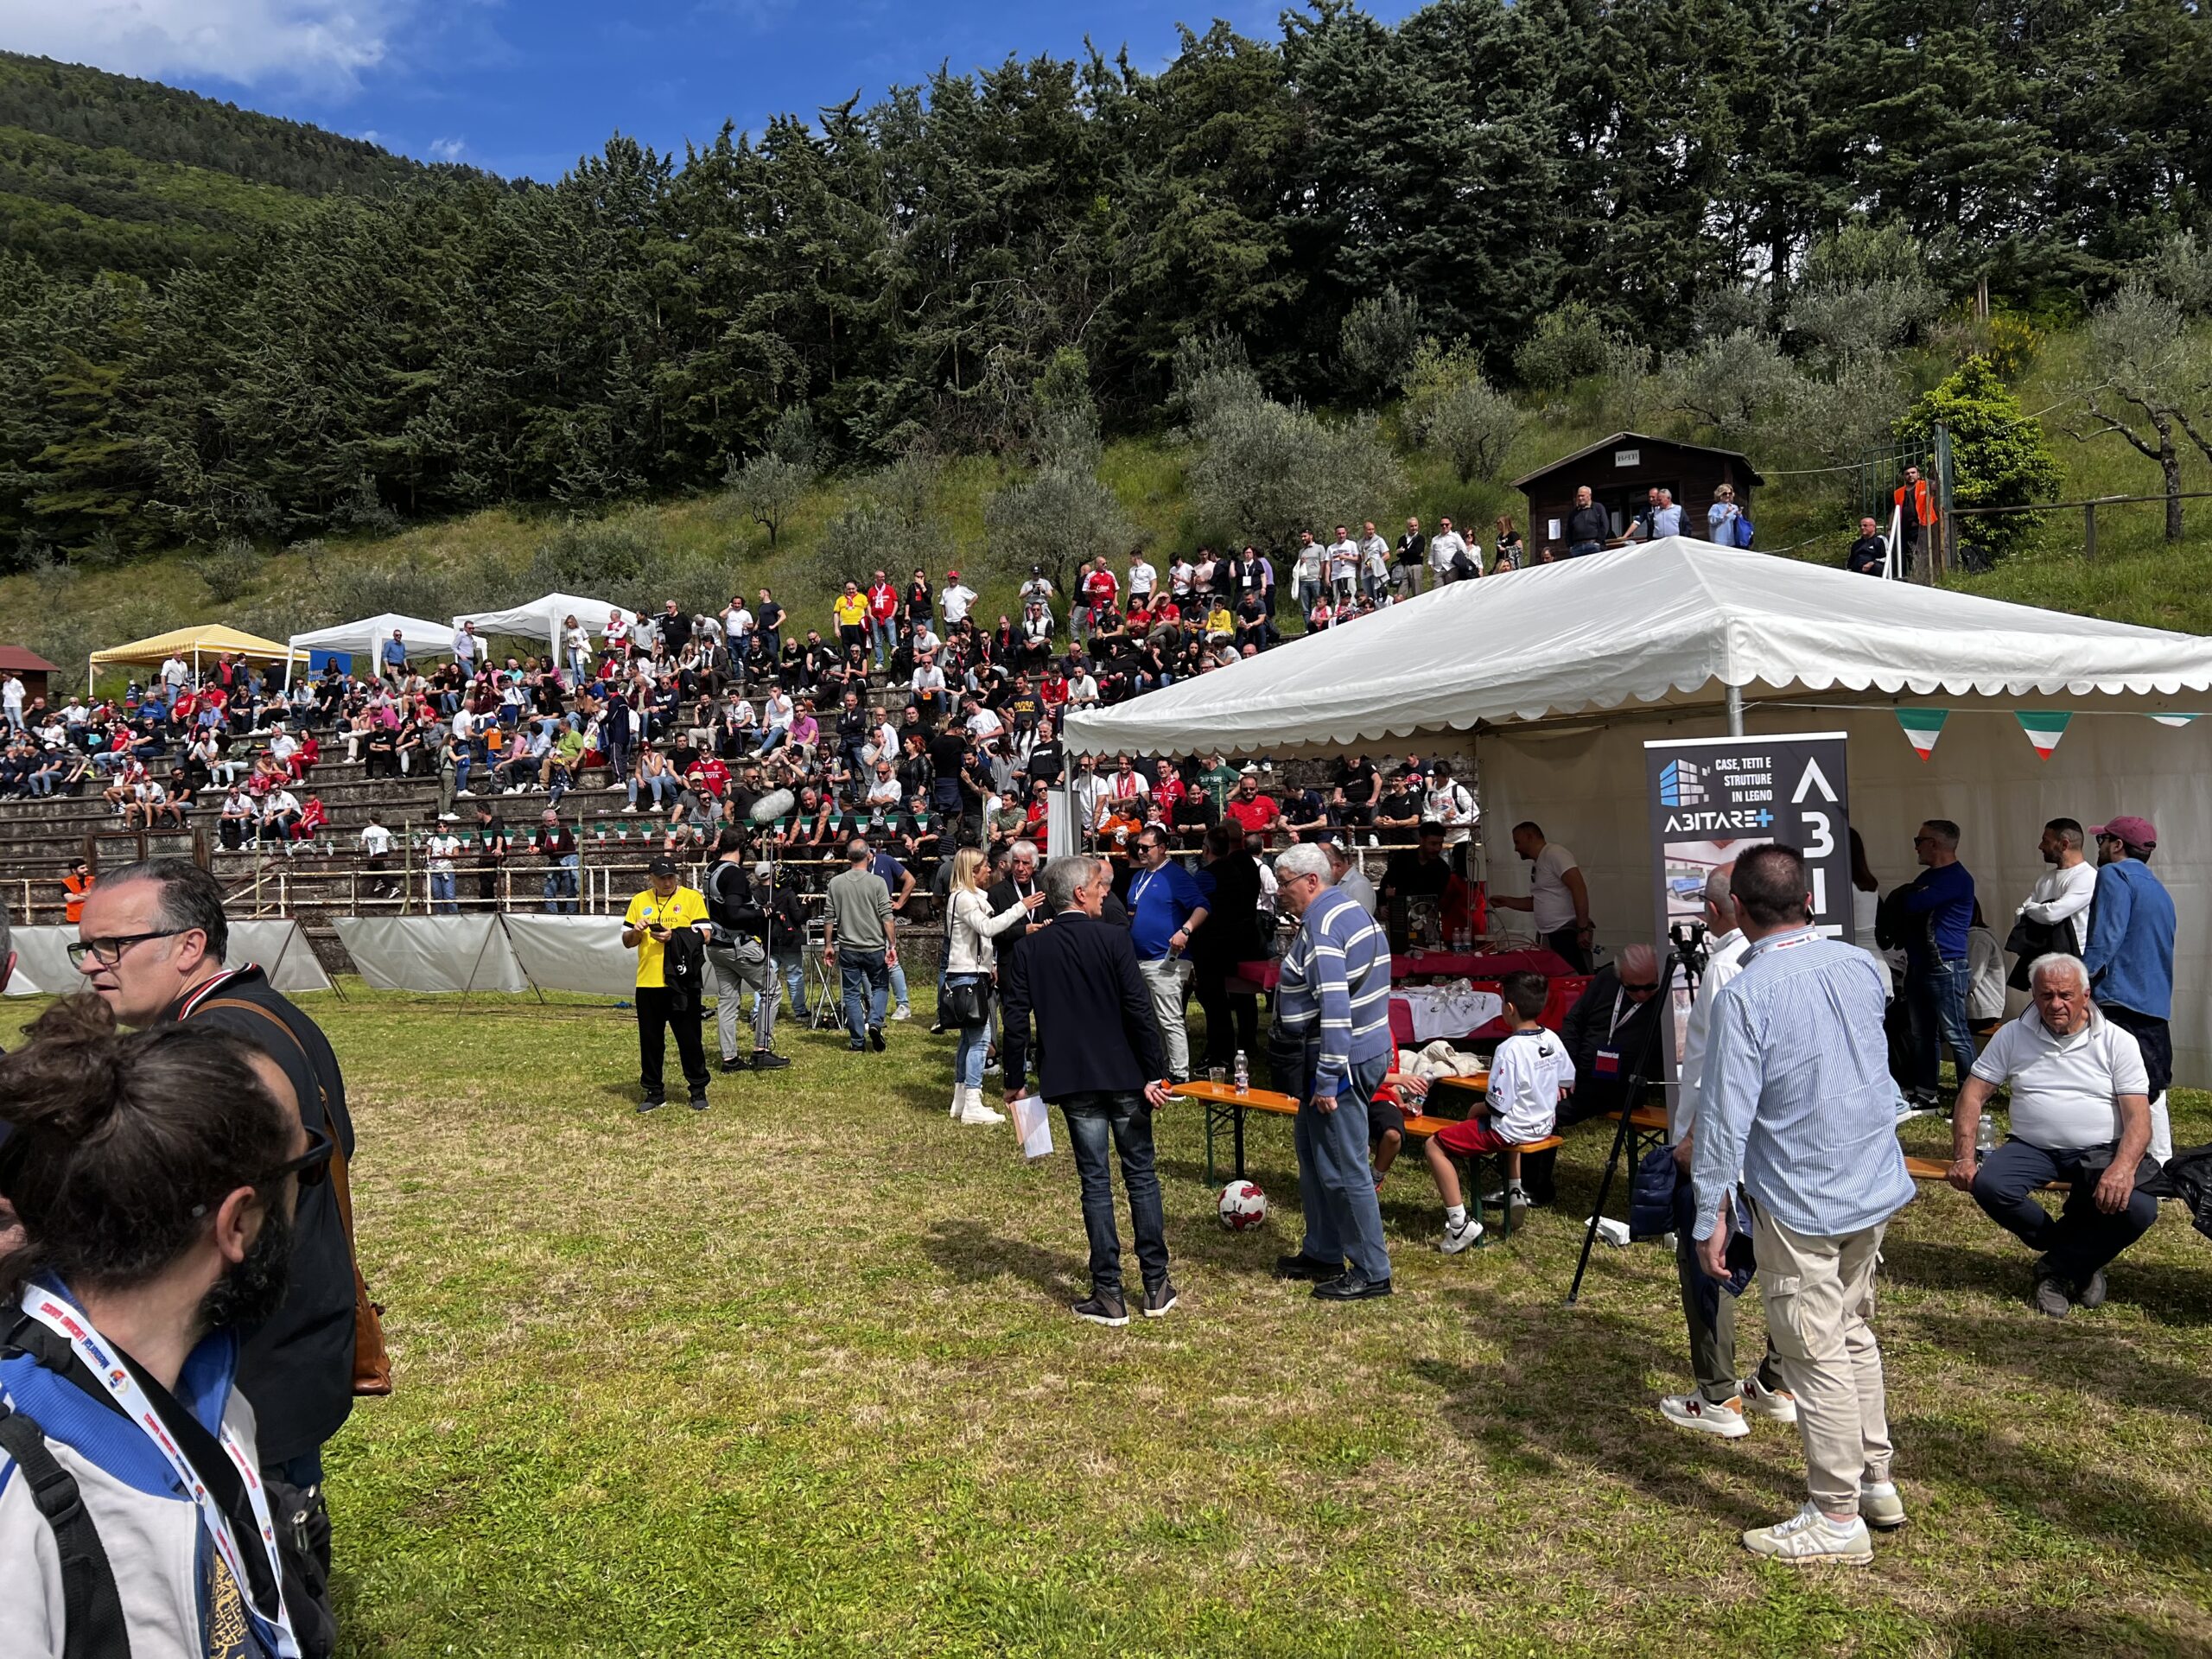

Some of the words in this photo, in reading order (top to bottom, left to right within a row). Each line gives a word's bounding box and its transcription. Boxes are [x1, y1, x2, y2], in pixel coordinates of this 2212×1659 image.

[1715, 758, 1740, 772] CASE,
[1741, 757, 1764, 769] TETTI
[1765, 756, 1772, 768] E
[1724, 772, 1773, 787] STRUTTURE
[1732, 791, 1743, 803] IN
[1745, 789, 1773, 802] LEGNO
[81, 1337, 111, 1370] Memorial
